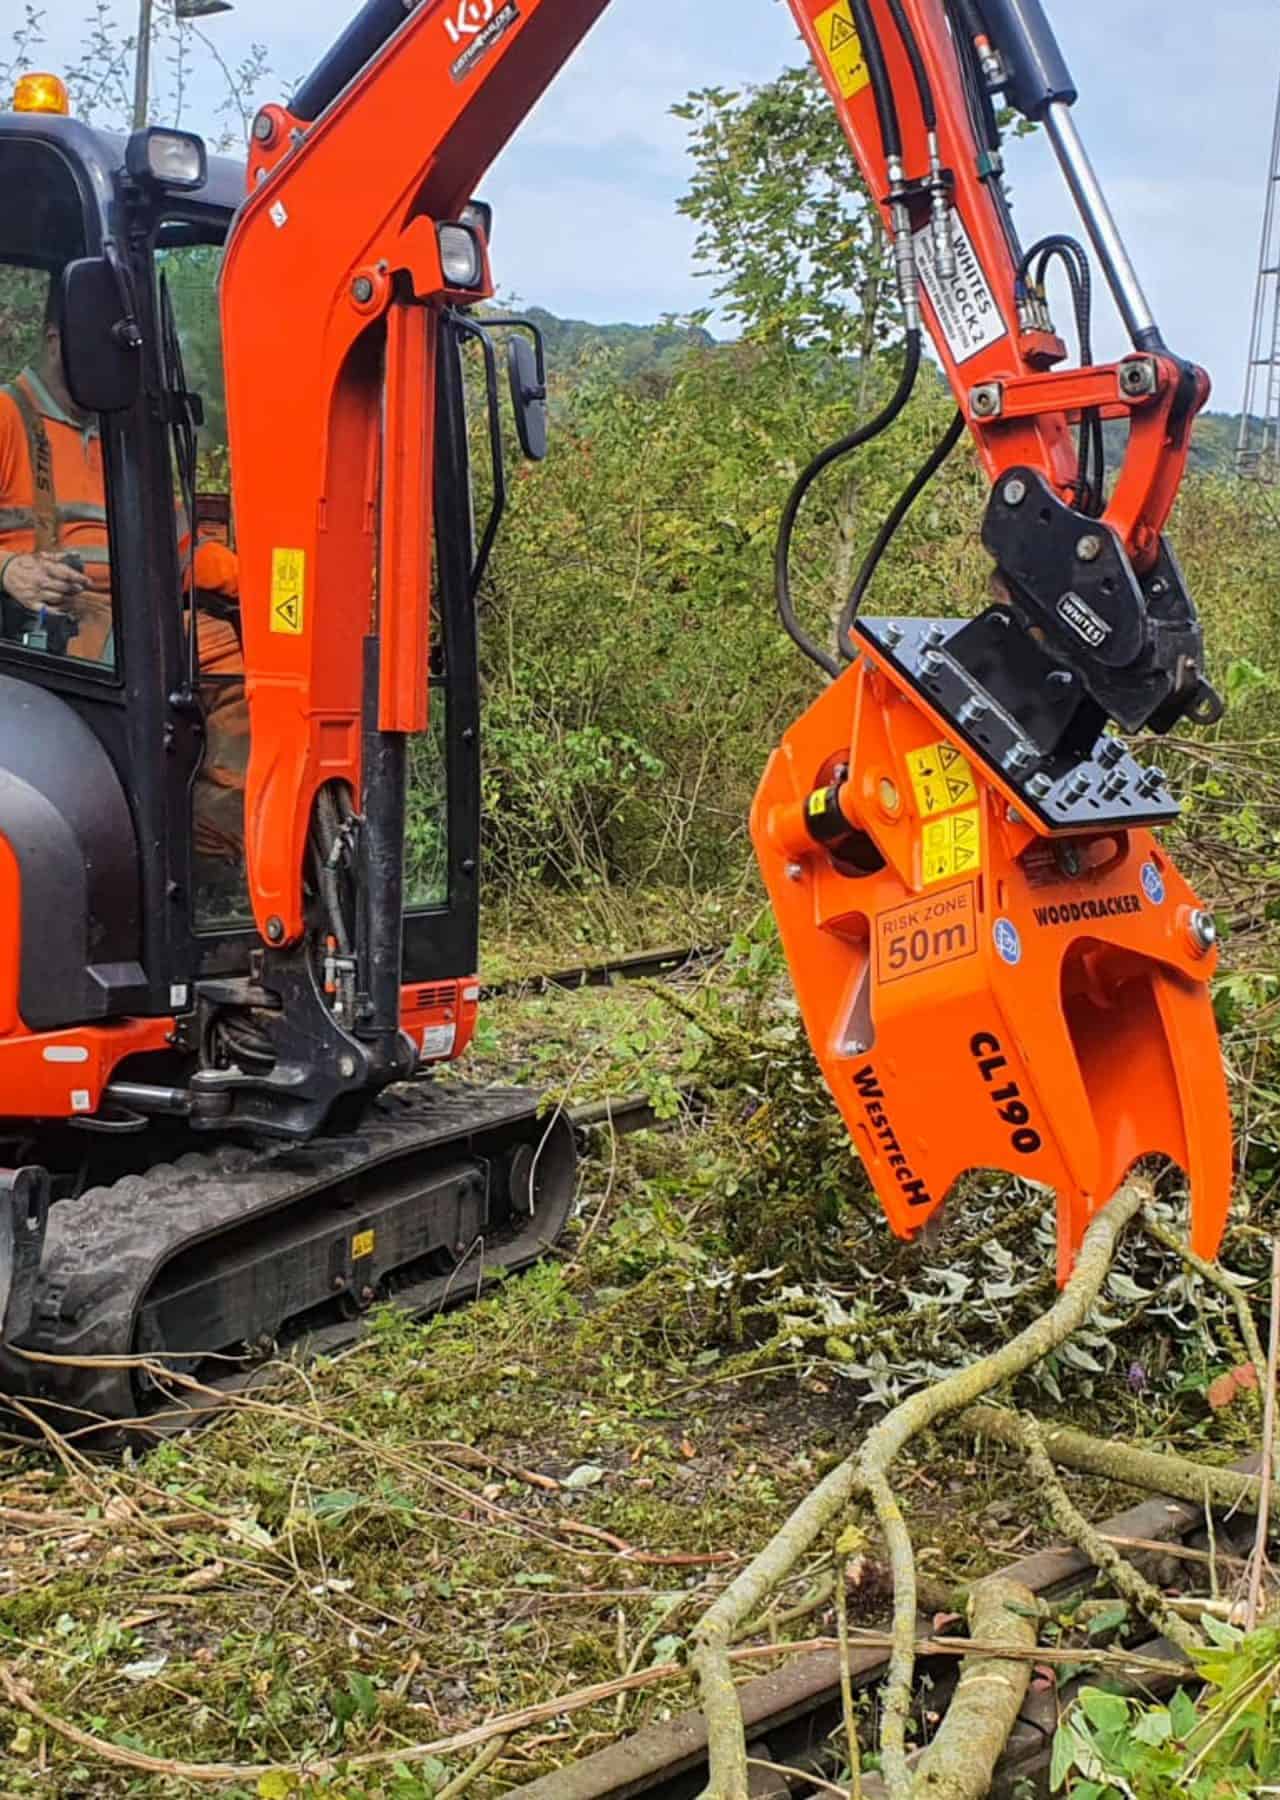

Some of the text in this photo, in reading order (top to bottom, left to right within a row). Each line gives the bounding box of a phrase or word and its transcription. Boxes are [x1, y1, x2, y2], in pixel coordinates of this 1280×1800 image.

[952, 235, 992, 315] WHITES
[1062, 600, 1102, 641] WHITES
[882, 895, 968, 935] RISK ZONE
[1033, 894, 1142, 927] WOODCRACKER
[887, 922, 967, 970] 50m
[970, 1031, 1041, 1154] CL 190
